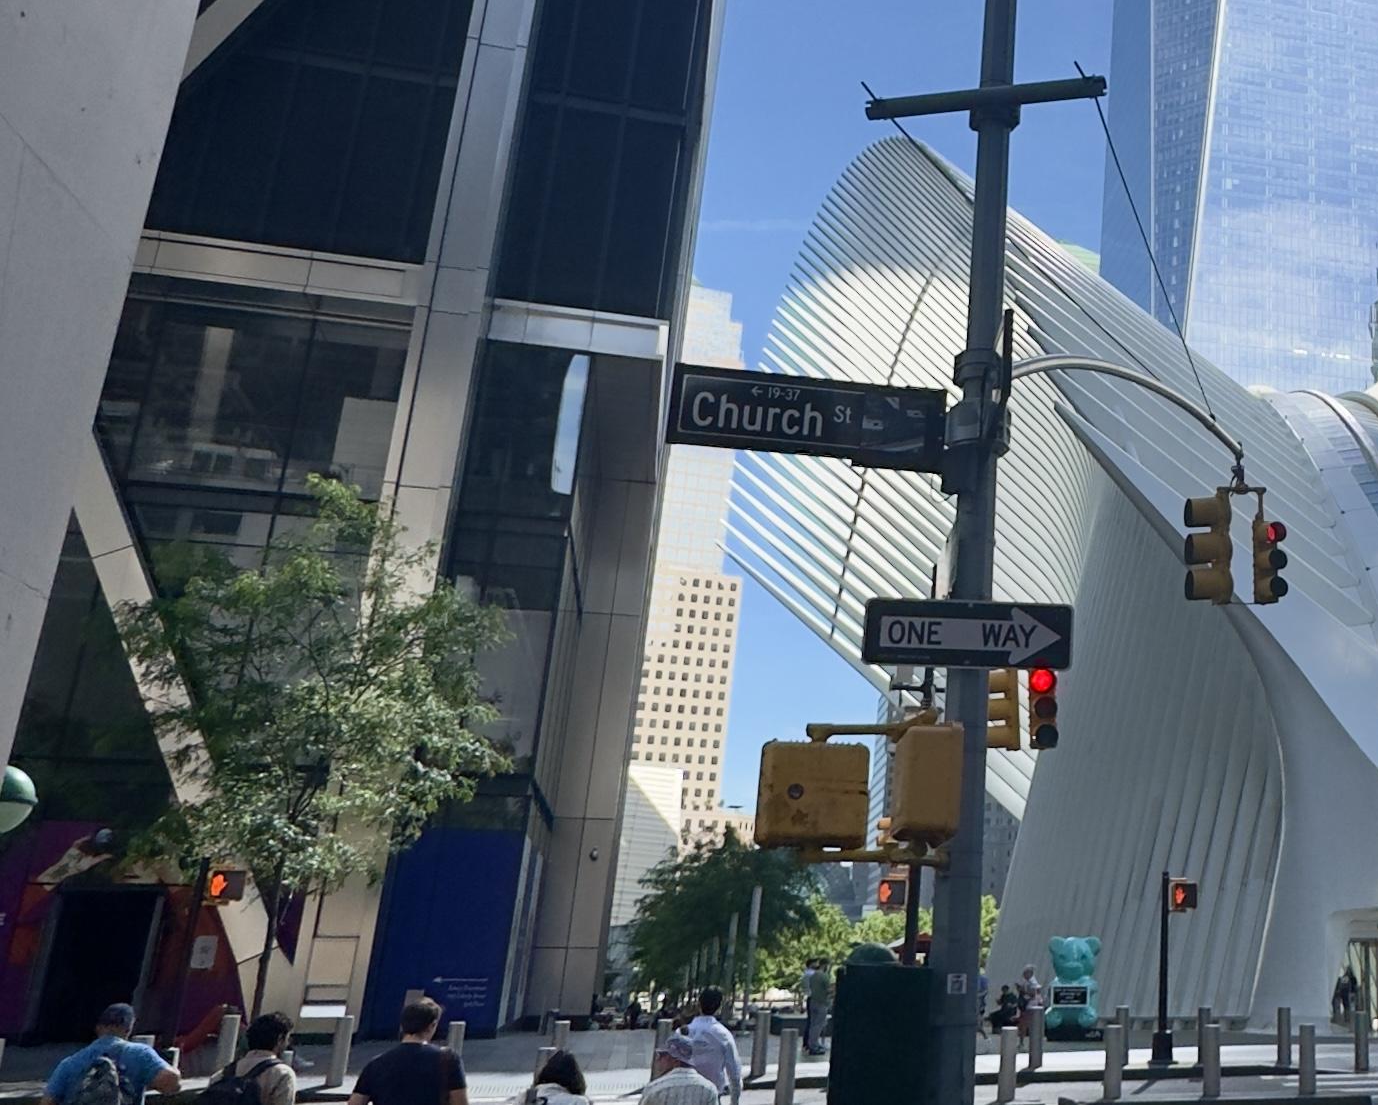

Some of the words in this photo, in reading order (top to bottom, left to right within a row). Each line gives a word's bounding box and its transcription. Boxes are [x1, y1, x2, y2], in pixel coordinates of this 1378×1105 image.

[768, 386, 801, 400] 19-37
[692, 392, 823, 437] Church
[833, 405, 852, 424] St
[888, 620, 942, 645] ONE
[982, 623, 1038, 648] WAY
